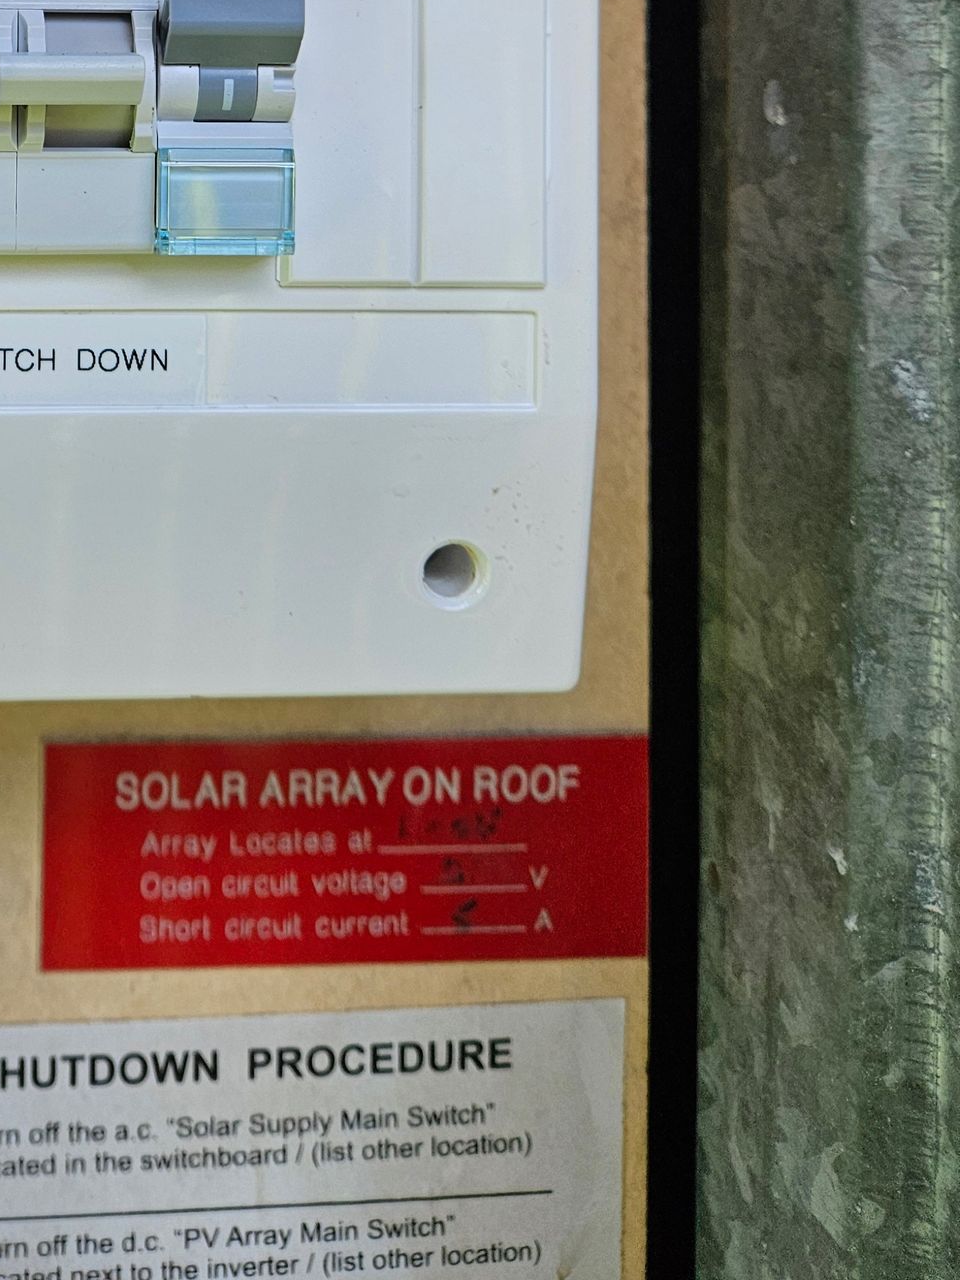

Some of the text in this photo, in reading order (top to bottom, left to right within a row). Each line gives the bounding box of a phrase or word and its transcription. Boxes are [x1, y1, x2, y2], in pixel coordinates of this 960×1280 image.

[77, 348, 168, 373] DOWN
[115, 764, 580, 811] SOLAR ARRAY ON ROOF
[141, 831, 217, 861] Array
[347, 828, 372, 854] at
[139, 865, 549, 901] Open circuit voltage V
[139, 908, 554, 943] Short circuit current A
[248, 1037, 512, 1080] PROCEDURE
[28, 1121, 60, 1145] off
[68, 1122, 106, 1143] the
[113, 1123, 159, 1142] a.c.
[249, 1111, 333, 1139] Supply
[341, 1109, 398, 1130] Main
[65, 1153, 87, 1175] in
[95, 1153, 132, 1173] the
[140, 1144, 288, 1171] switchboard
[311, 1141, 354, 1168] (list
[361, 1138, 424, 1161] other
[431, 1132, 533, 1157] location)
[36, 1234, 68, 1257] off
[76, 1234, 113, 1255] the
[121, 1231, 165, 1254] d.c.
[226, 1226, 292, 1250] Array
[300, 1221, 359, 1243] Main
[70, 1264, 122, 1280] next
[130, 1263, 153, 1280] to
[161, 1260, 199, 1280] the
[207, 1256, 300, 1279] inverter
[322, 1251, 365, 1278] (list
[372, 1248, 435, 1270] other
[441, 1240, 542, 1266] location)
